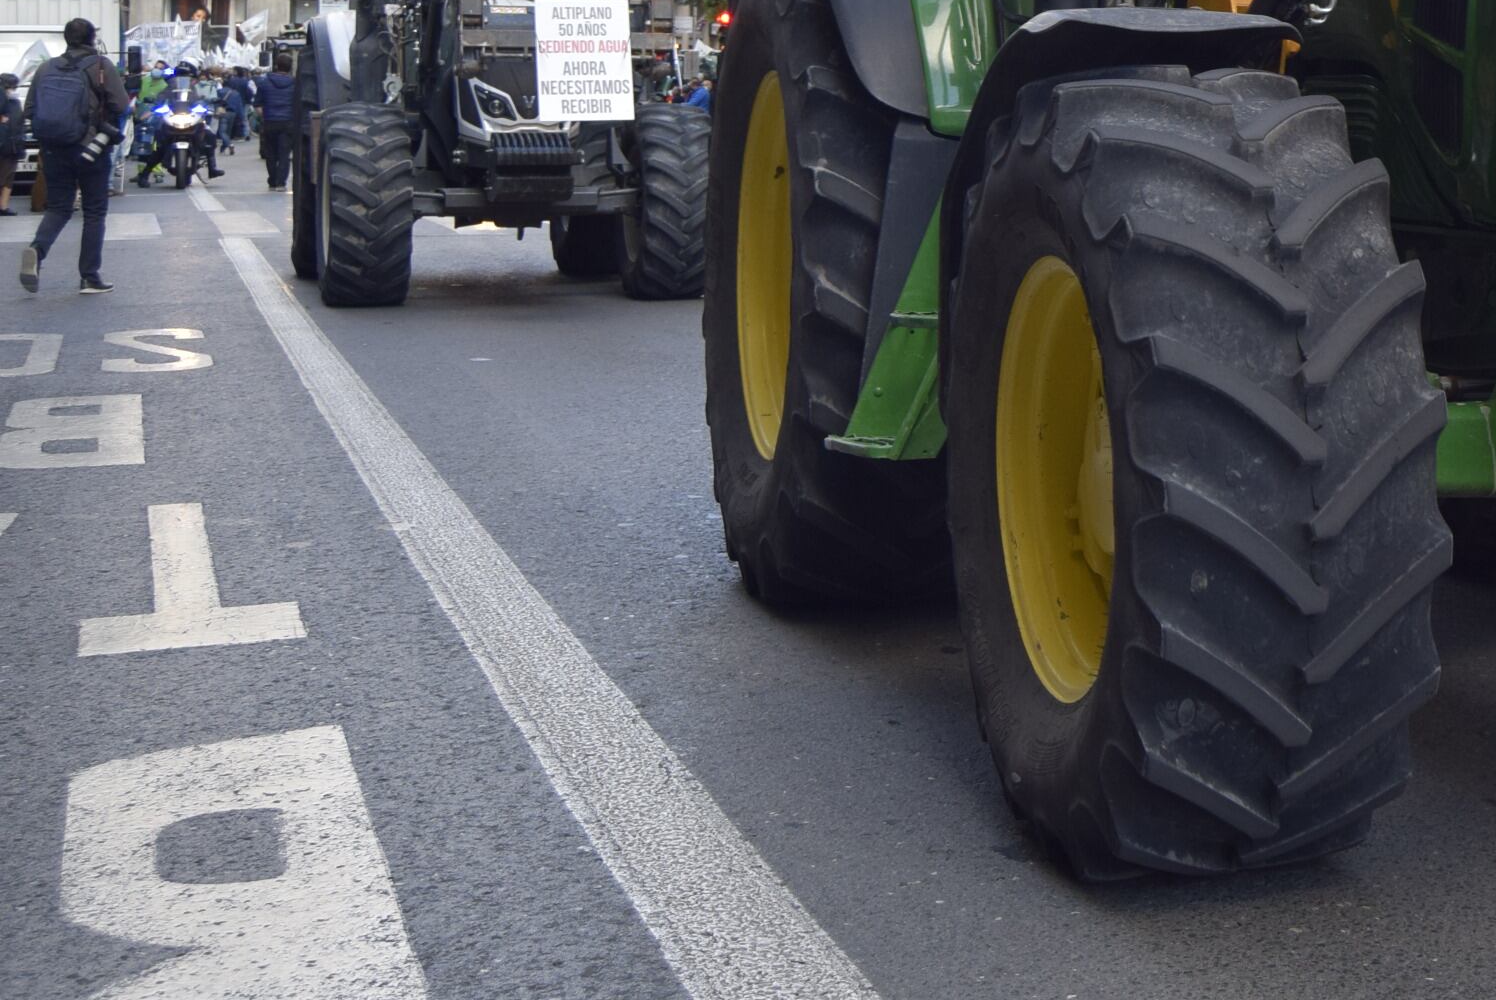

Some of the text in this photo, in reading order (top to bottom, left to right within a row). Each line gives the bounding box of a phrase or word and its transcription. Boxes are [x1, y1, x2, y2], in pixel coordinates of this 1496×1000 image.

[552, 6, 612, 20] ALTIPLANO
[559, 21, 607, 36] 50 AÑOS
[539, 39, 628, 54] CEDIENDO AGUA
[563, 61, 607, 75] AHORA
[541, 79, 630, 95] NECESITAMOS
[561, 99, 612, 114] RECIBIR
